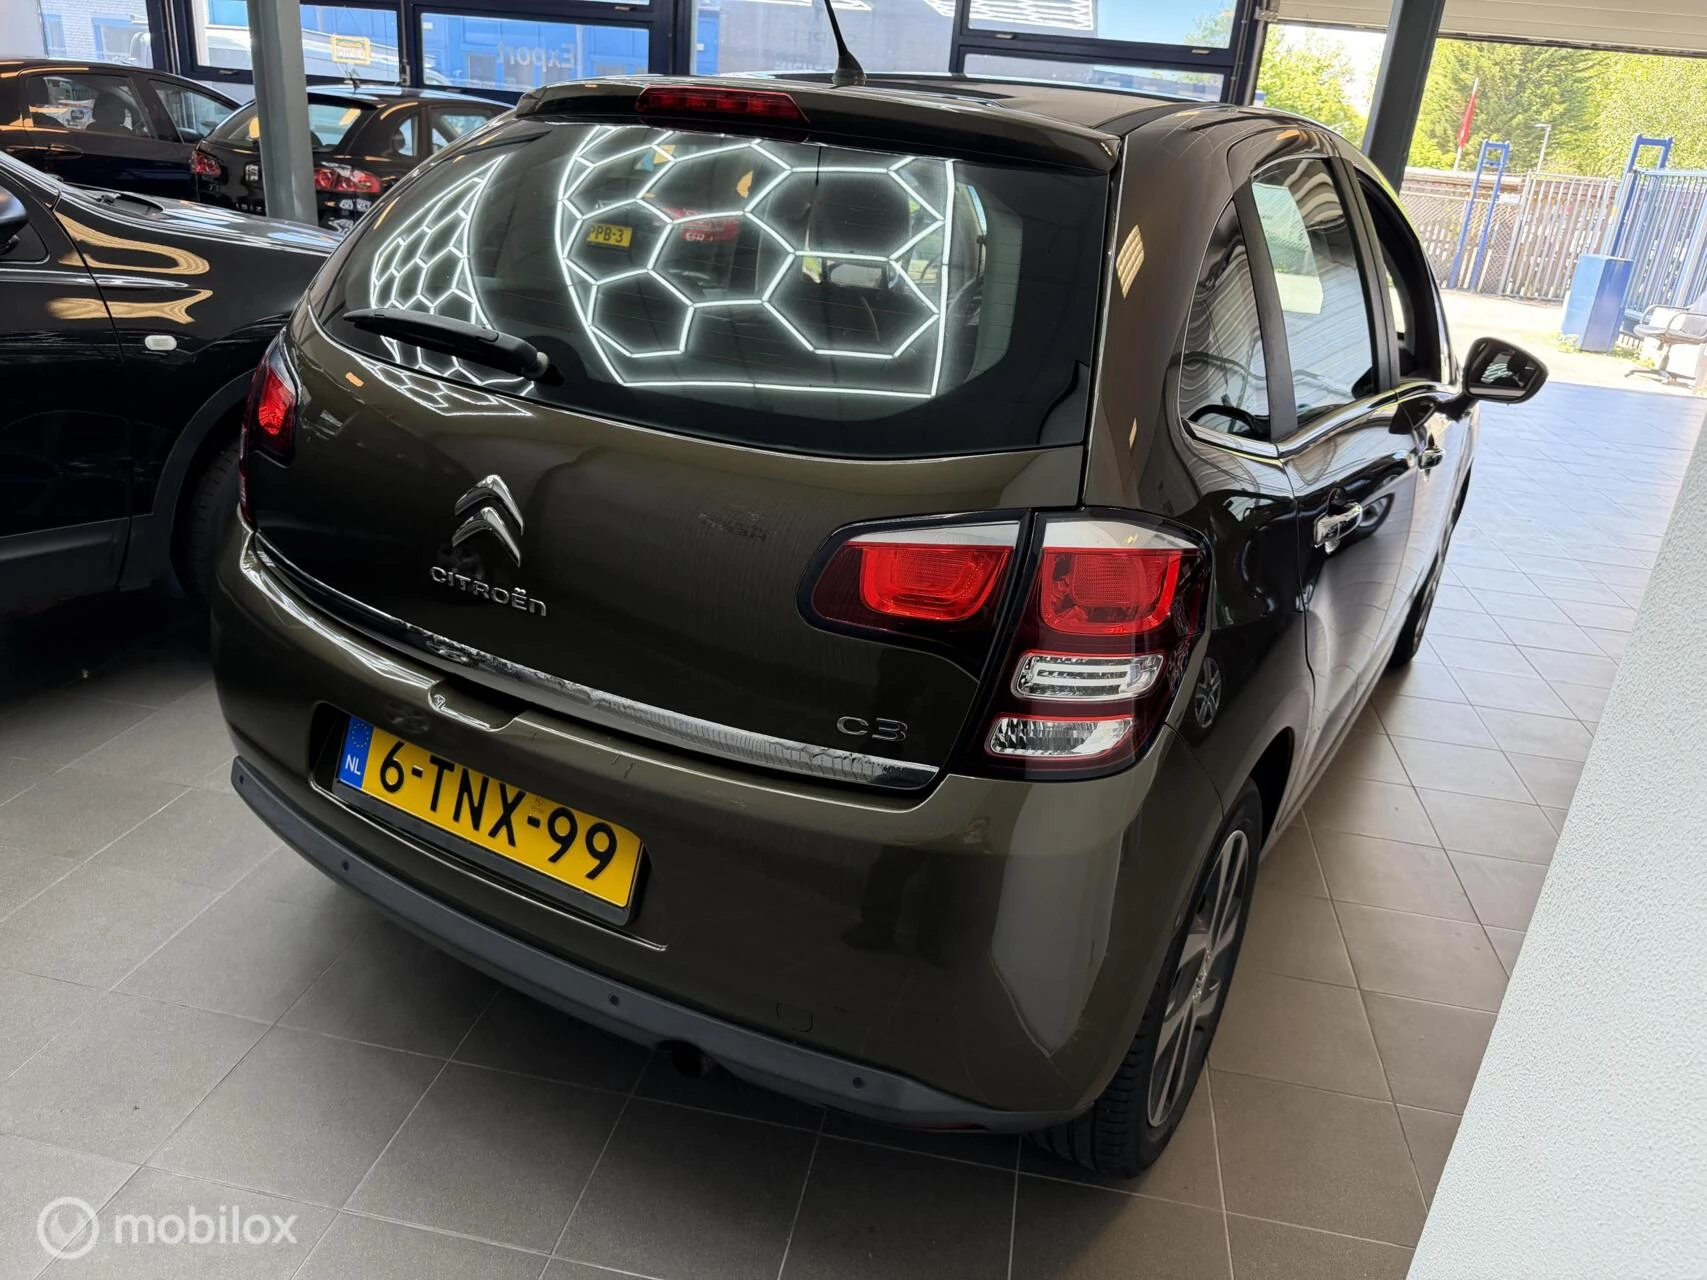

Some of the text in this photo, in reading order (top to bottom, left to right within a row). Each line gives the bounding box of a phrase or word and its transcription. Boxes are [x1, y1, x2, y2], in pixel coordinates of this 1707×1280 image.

[836, 715, 908, 742] C3
[344, 754, 362, 777] NL
[379, 741, 618, 880] 6-TNX-99
